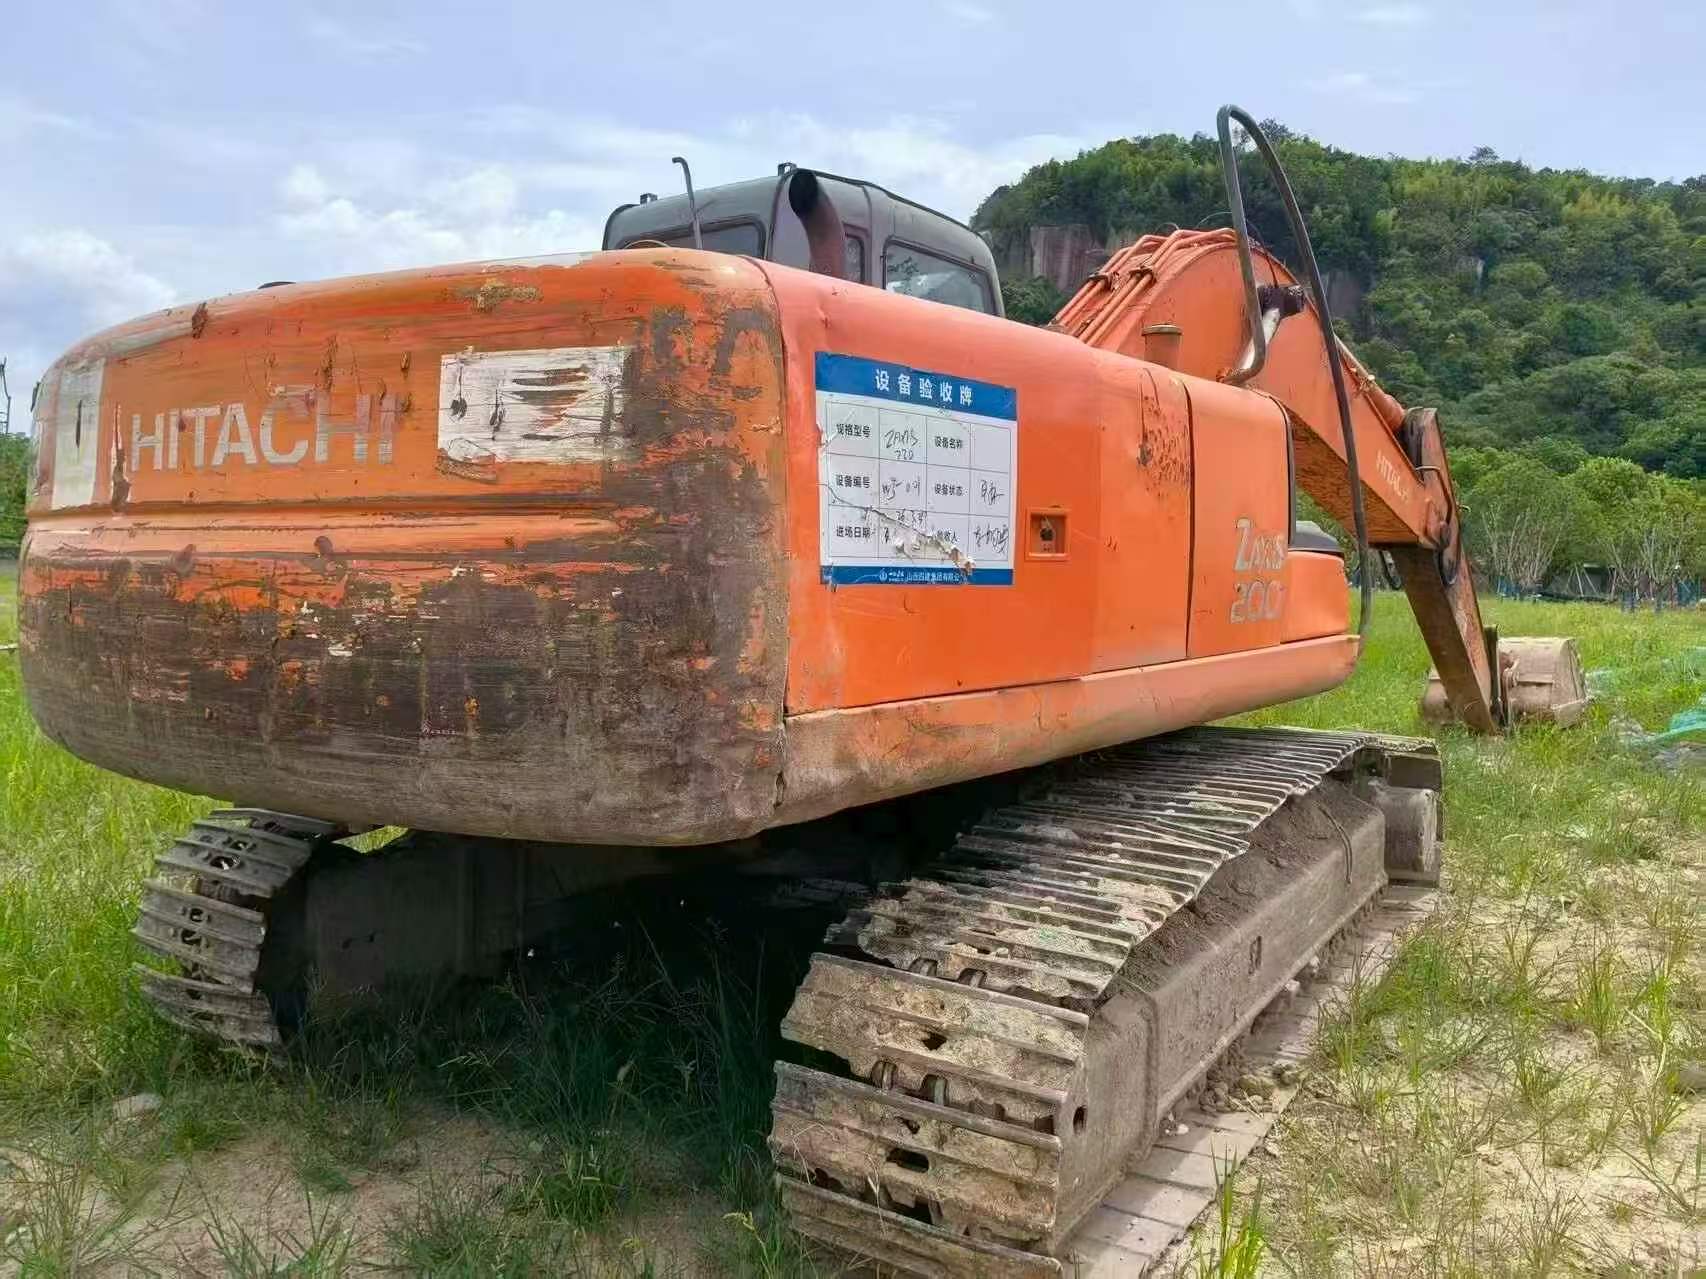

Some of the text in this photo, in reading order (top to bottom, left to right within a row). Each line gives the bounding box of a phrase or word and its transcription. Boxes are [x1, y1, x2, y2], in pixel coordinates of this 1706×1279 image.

[875, 368, 973, 406] 设备验收牌
[130, 391, 398, 472] HITACHI
[836, 423, 871, 438] 规格型号
[934, 435, 963, 449] 设备名称
[836, 474, 871, 489] 设备编号
[934, 483, 963, 497] 设备状态
[1230, 579, 1284, 624] 200
